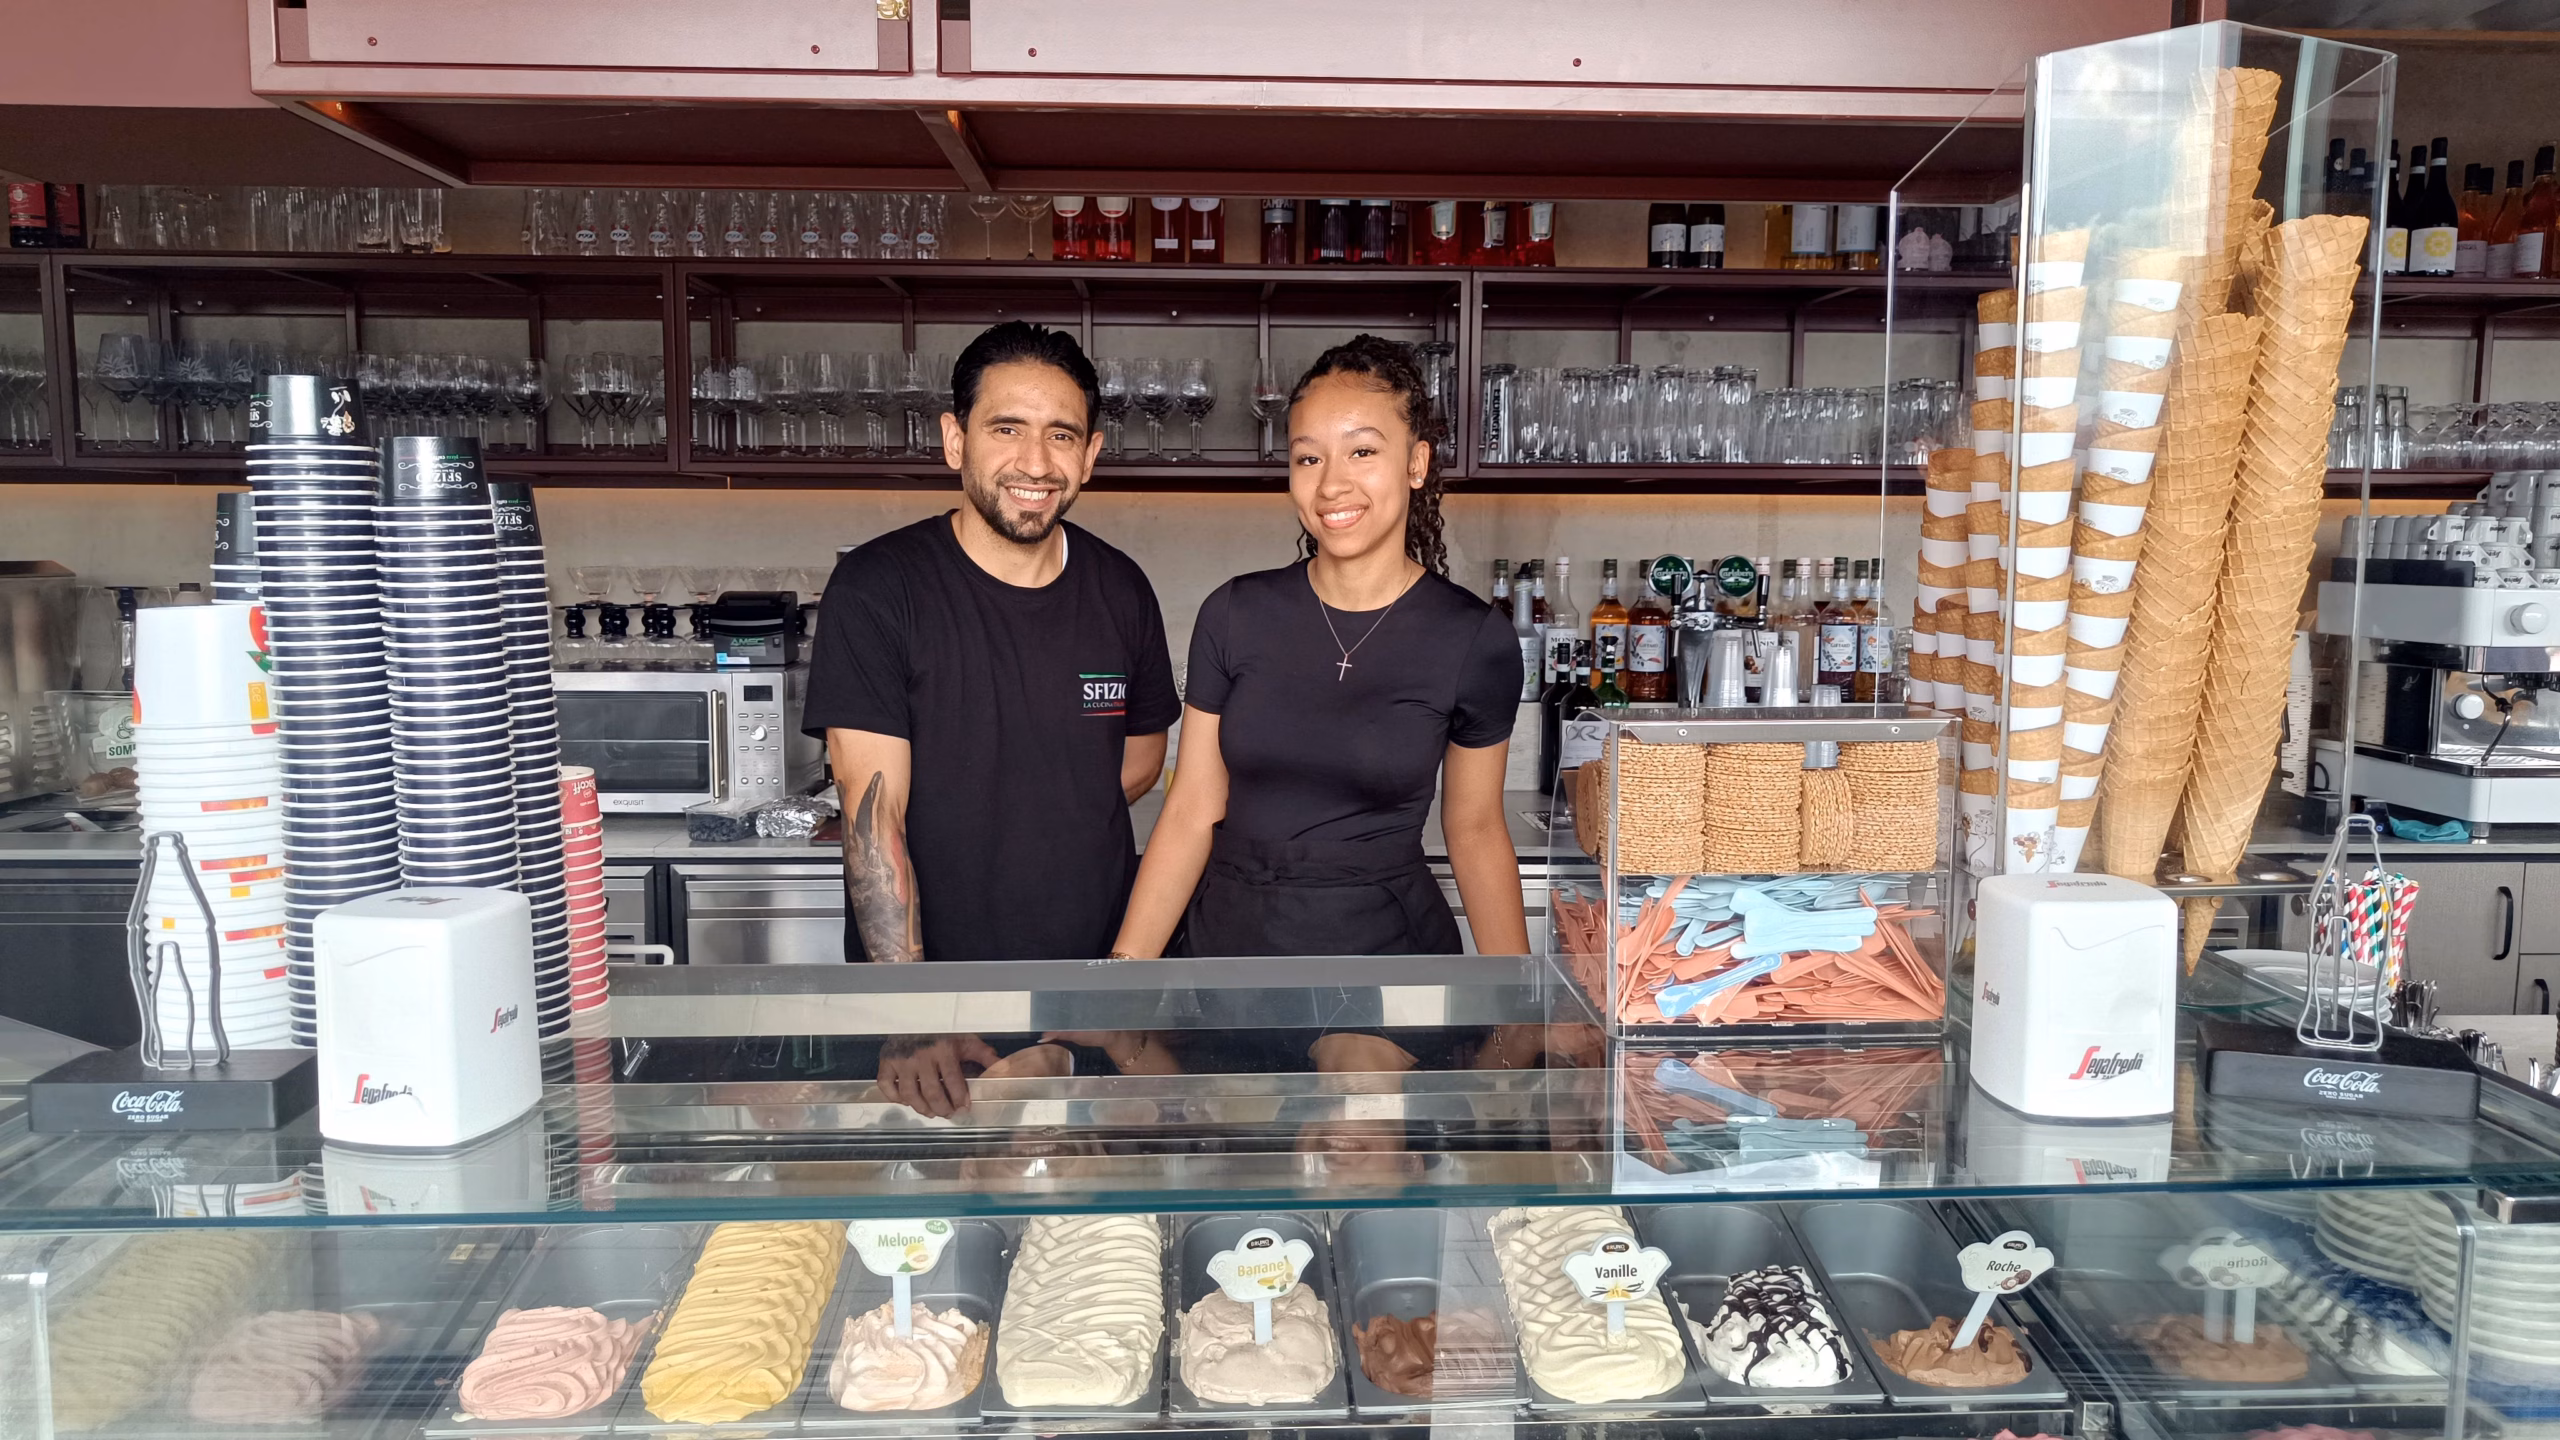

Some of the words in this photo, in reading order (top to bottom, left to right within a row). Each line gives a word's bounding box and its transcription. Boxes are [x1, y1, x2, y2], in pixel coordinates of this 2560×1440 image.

[1720, 567, 1754, 579] Carlsberg
[2303, 1067, 2383, 1093] Coca-Cola
[111, 1090, 184, 1113] Coca-Cola
[2339, 1091, 2364, 1099] SUGAR
[878, 1232, 925, 1247] Melone
[1237, 1261, 1284, 1277] Banane
[1595, 1264, 1638, 1279] Vanille
[1986, 1260, 2021, 1272] Roche
